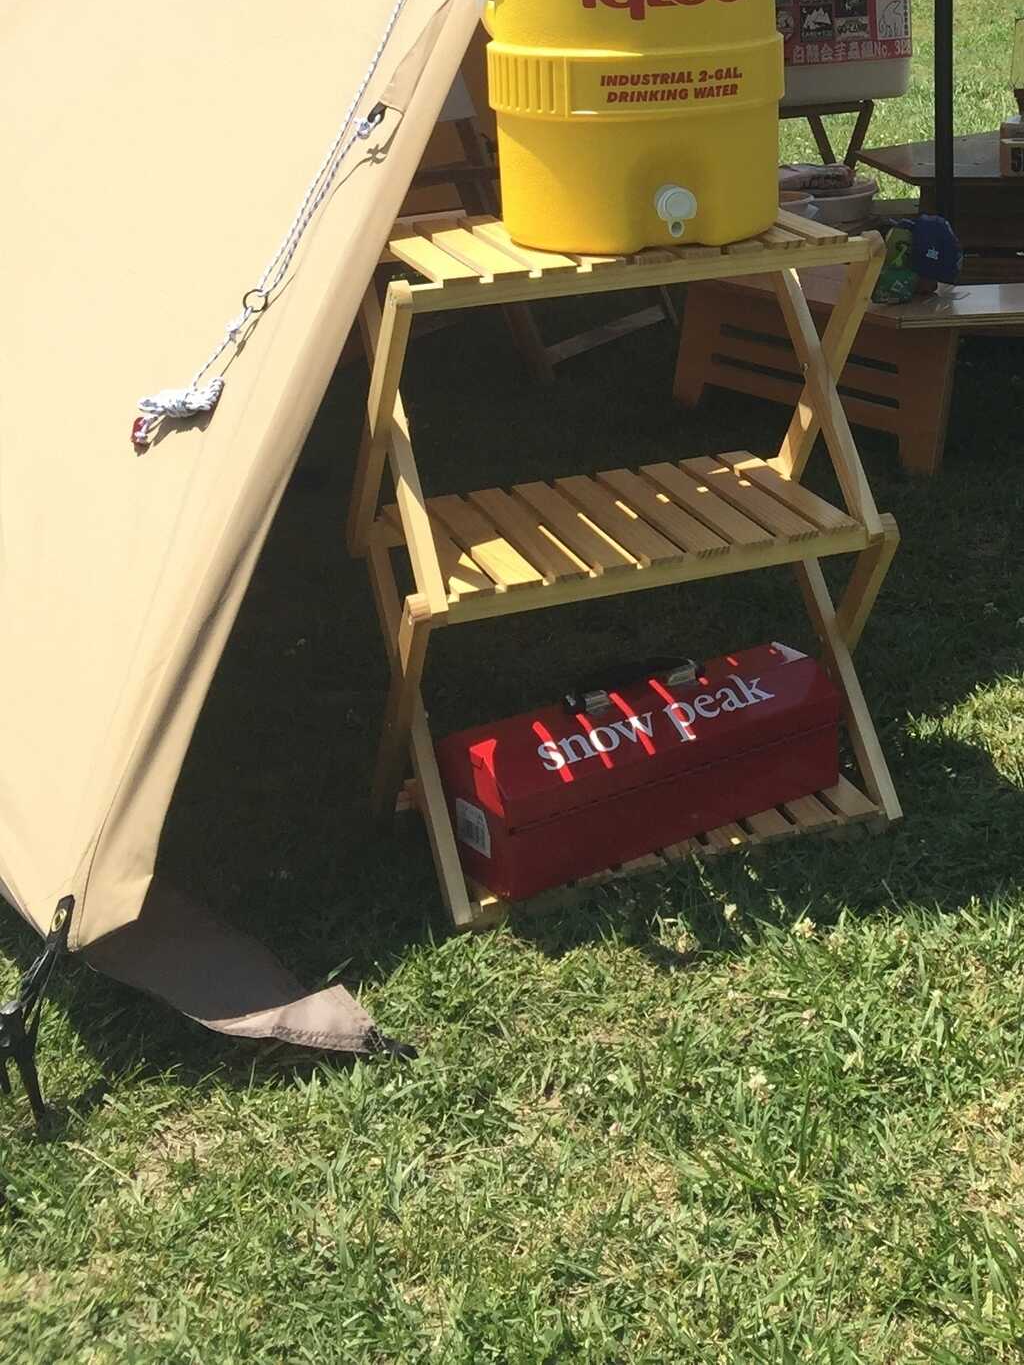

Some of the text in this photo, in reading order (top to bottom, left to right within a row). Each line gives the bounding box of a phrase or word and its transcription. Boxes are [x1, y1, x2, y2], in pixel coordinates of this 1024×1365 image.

[600, 67, 743, 87] INDUSTRIAL 2-GAL.
[606, 84, 739, 103] DRINKING WATER
[536, 674, 776, 771] snow peak
